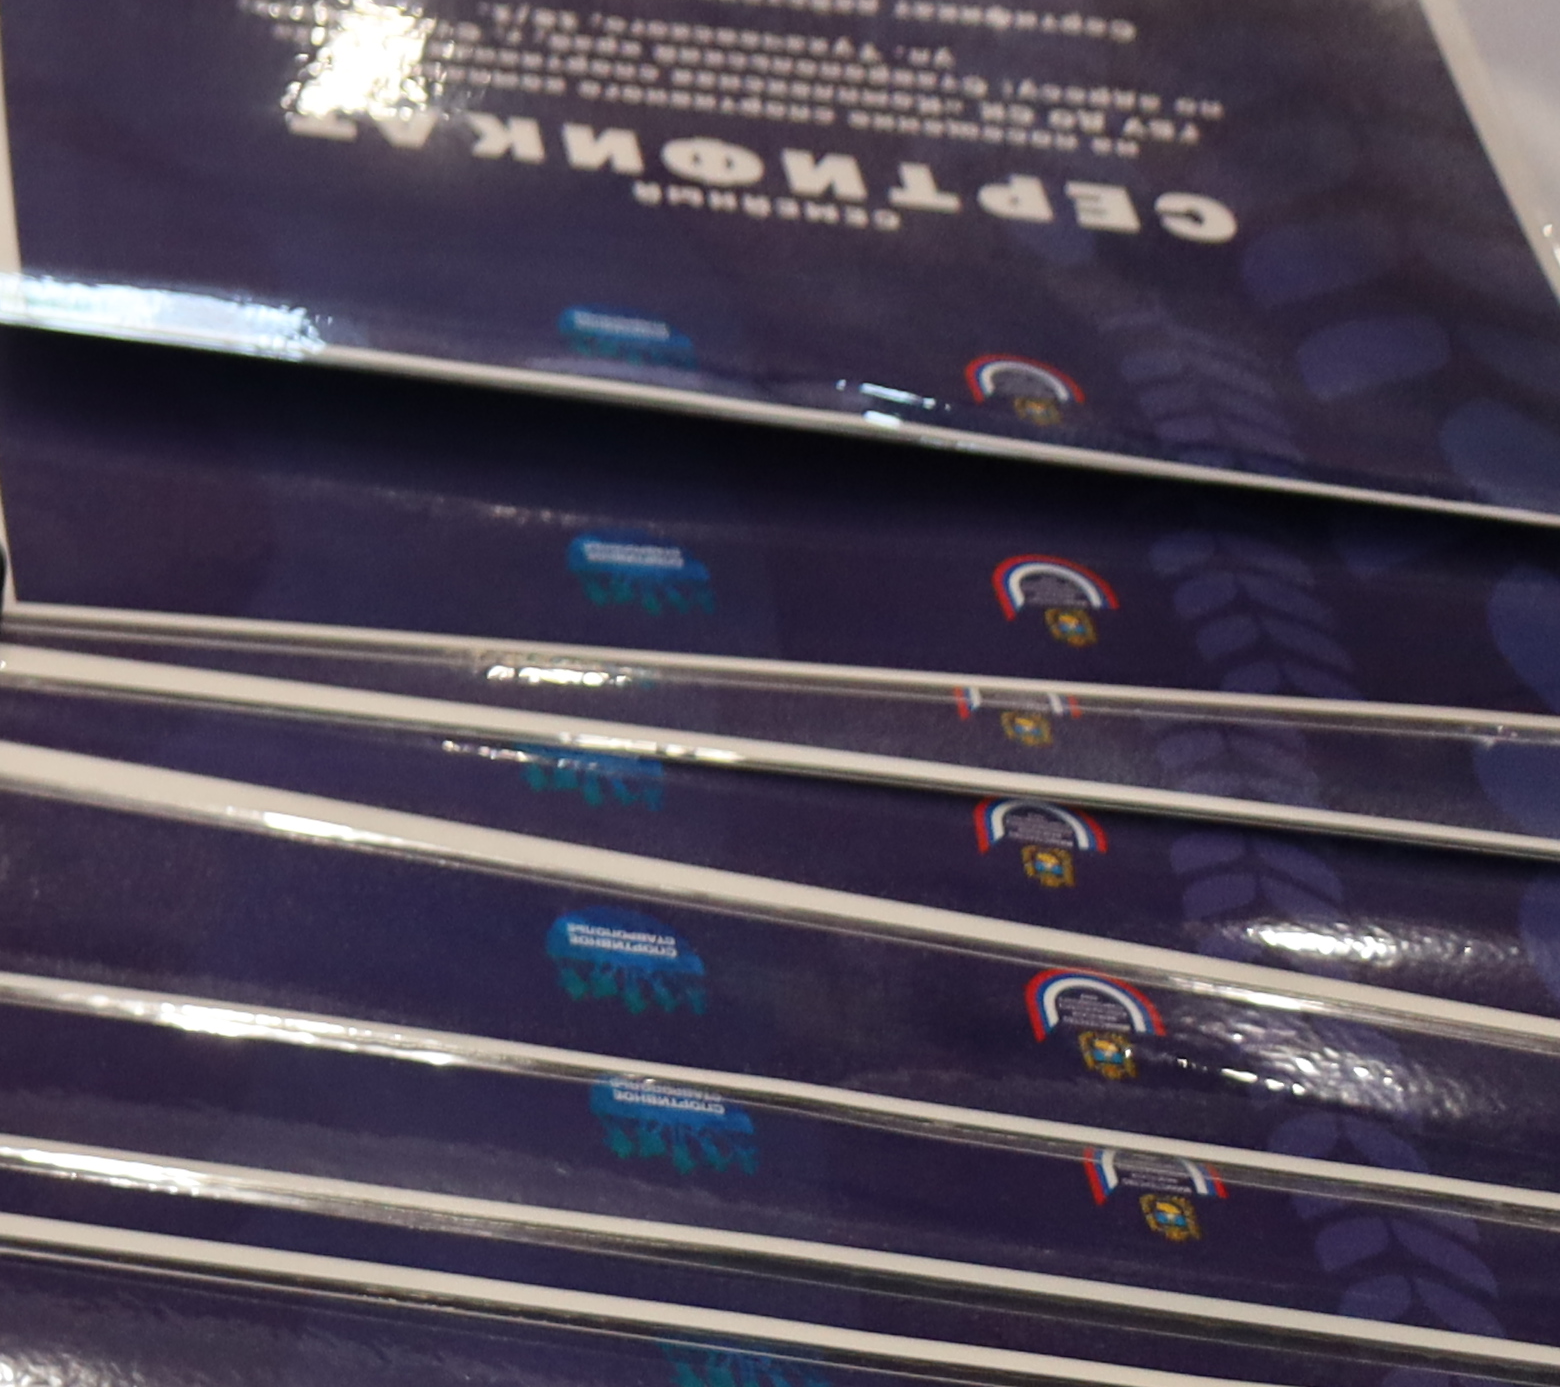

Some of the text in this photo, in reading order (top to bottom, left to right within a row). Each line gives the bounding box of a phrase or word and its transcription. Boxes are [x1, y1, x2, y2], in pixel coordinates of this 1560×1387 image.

[284, 96, 1238, 244] СЕРТИФИКАТ
[569, 934, 678, 958] СПОРТИВНОЕ
[613, 1089, 725, 1115] СПОРТИВНОЕ
